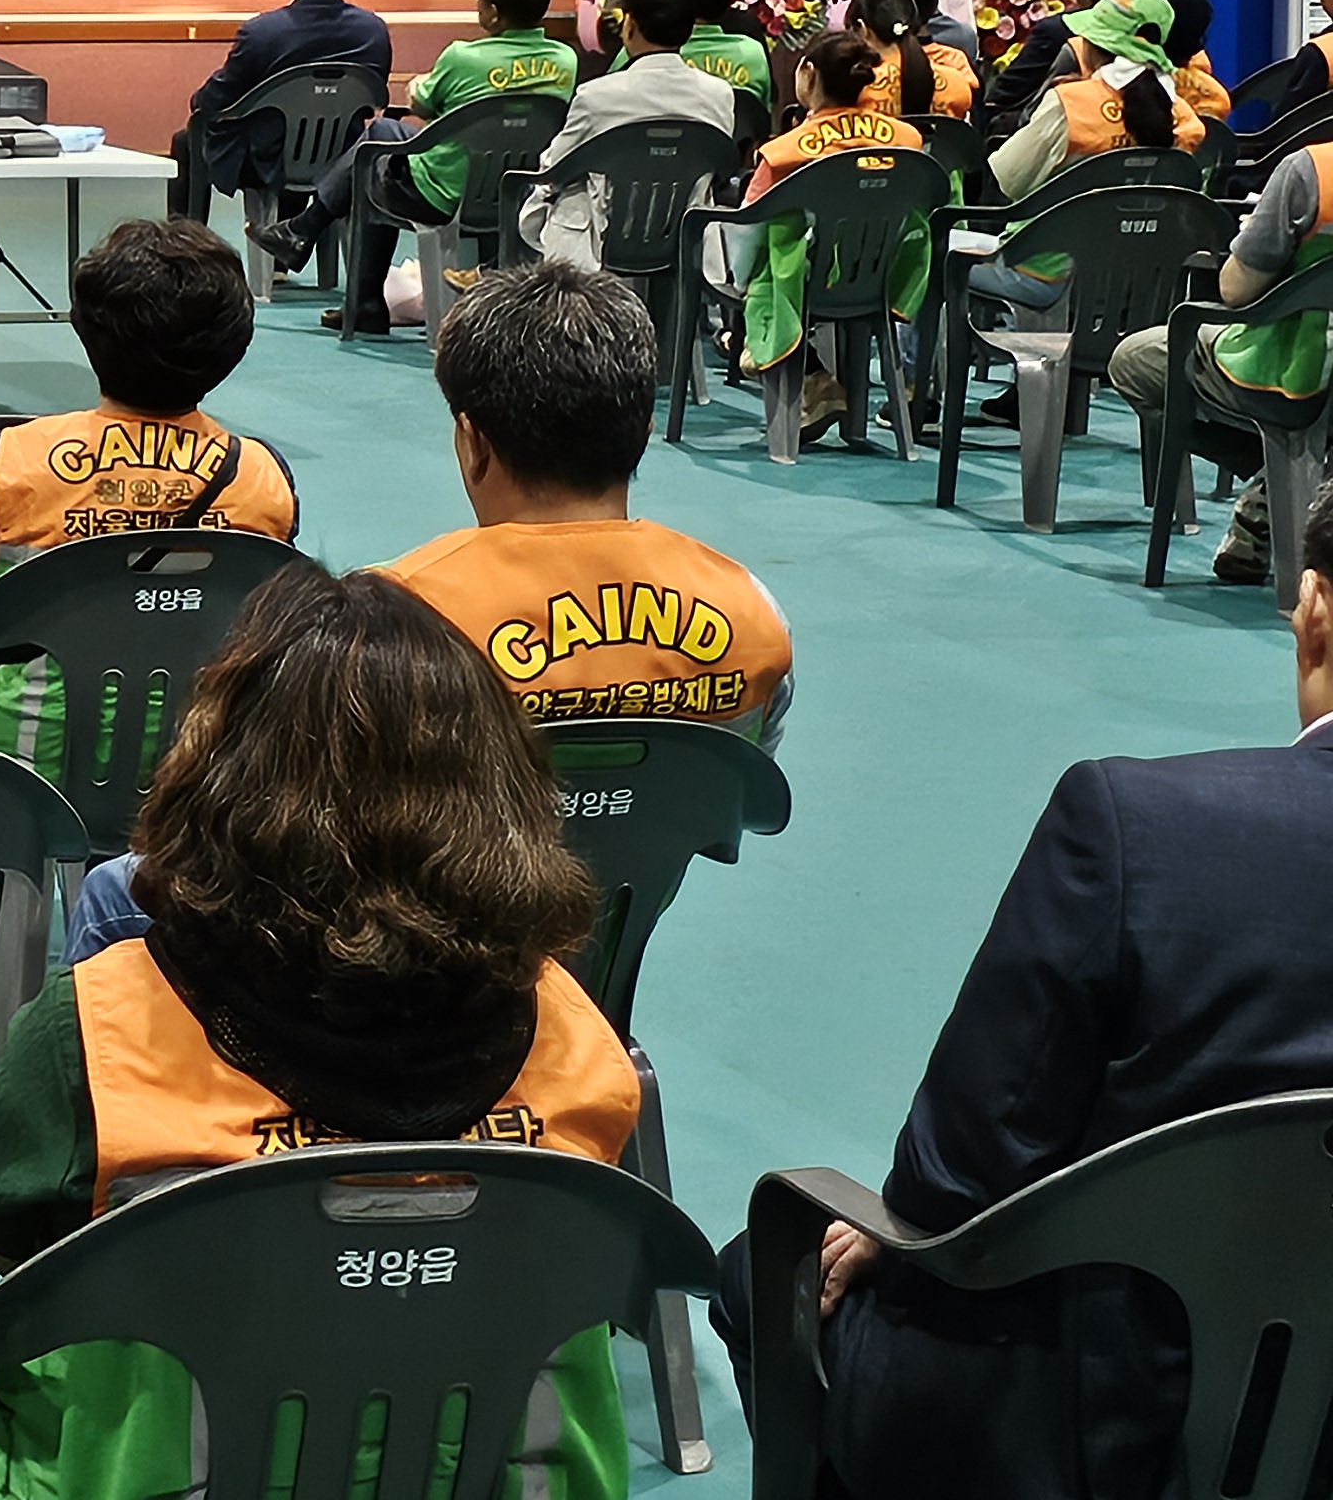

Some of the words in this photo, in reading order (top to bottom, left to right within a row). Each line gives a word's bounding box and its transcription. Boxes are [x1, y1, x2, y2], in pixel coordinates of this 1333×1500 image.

[797, 111, 895, 156] CAIND
[133, 587, 204, 613] 청양읍
[487, 581, 734, 683] CAIND
[516, 669, 748, 723] 양군자율방재단
[335, 1245, 460, 1290] 청양읍
